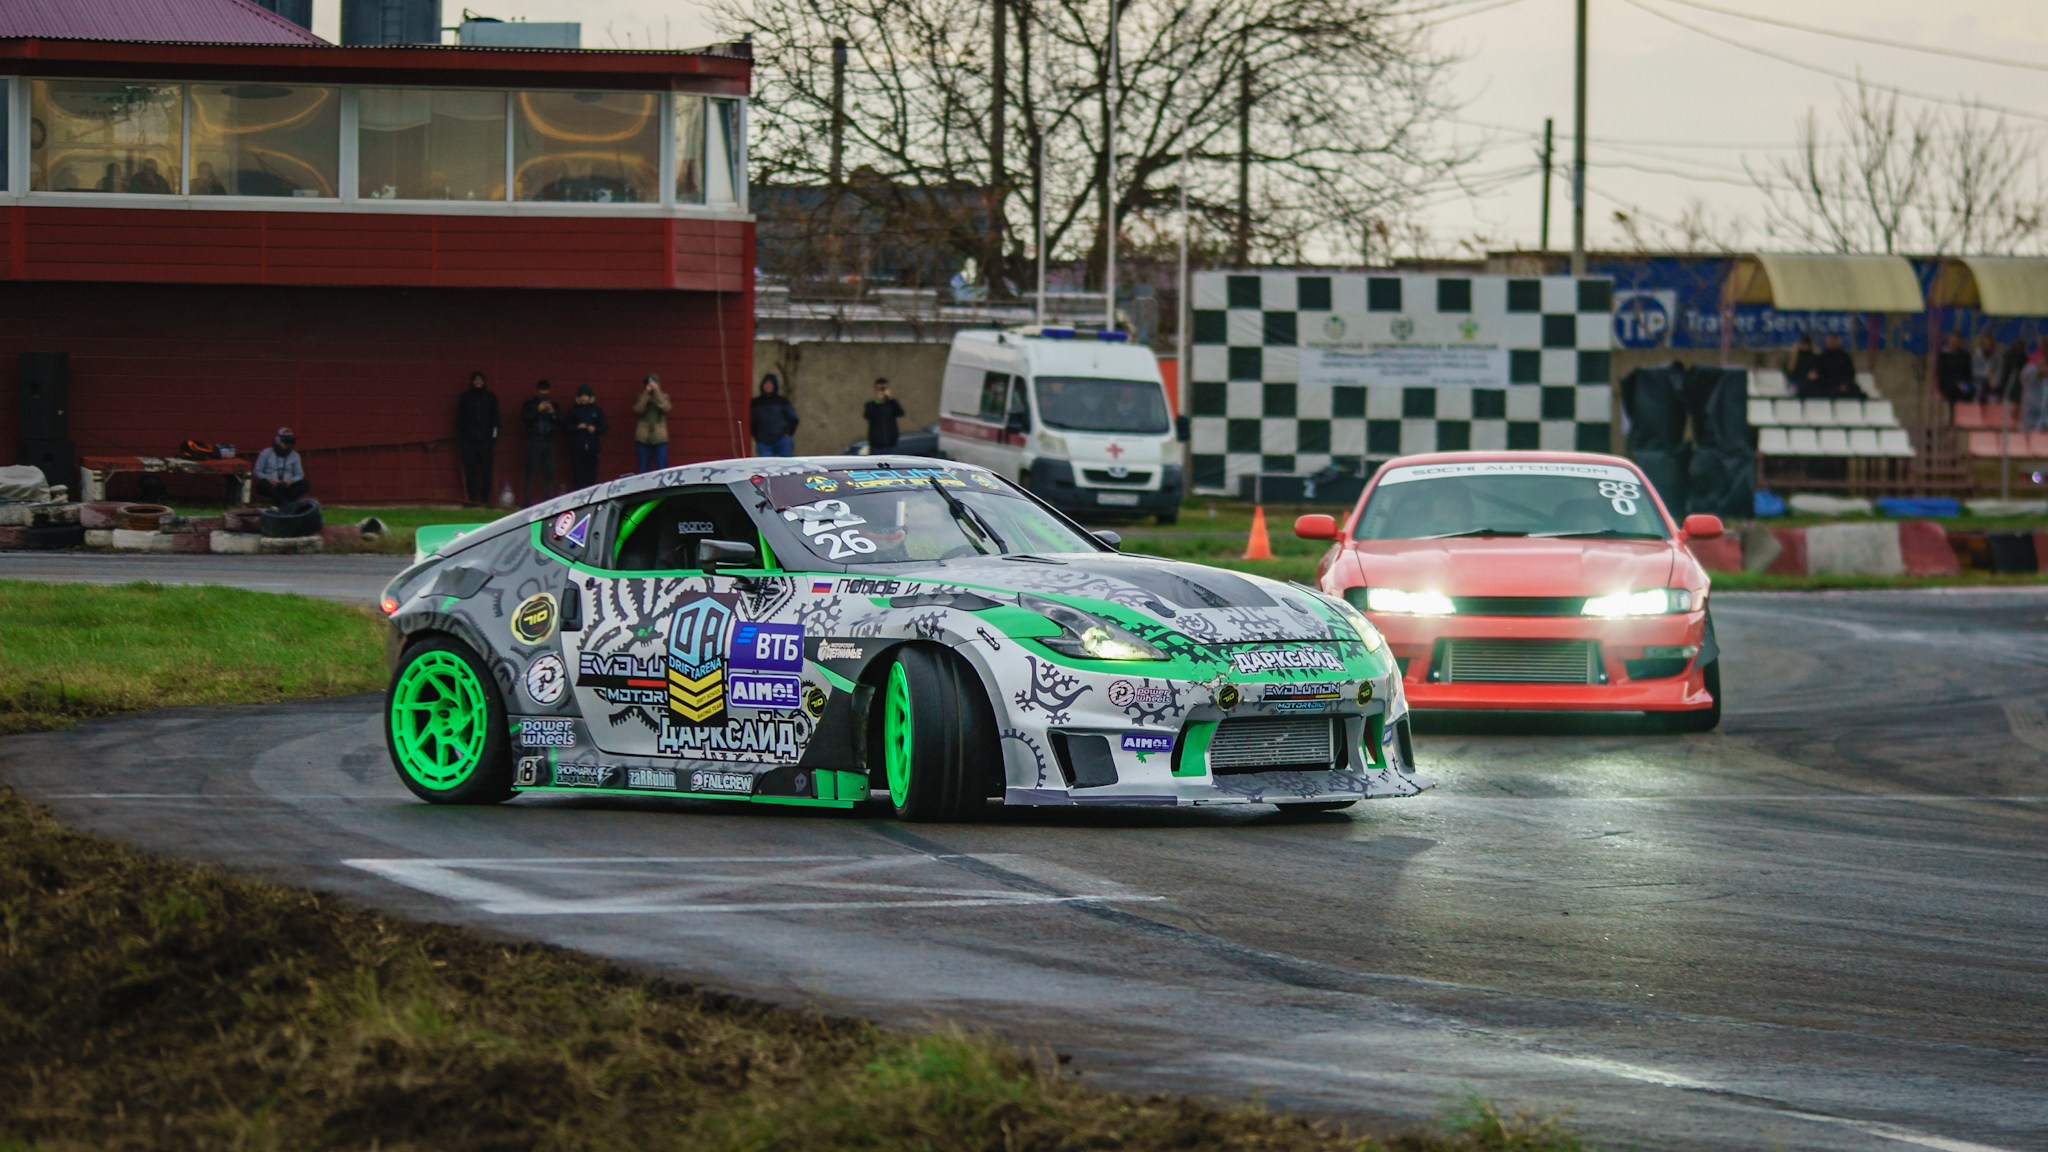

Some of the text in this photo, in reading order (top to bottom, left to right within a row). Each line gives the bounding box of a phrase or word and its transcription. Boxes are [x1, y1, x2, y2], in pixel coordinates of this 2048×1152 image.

[1622, 311, 1668, 340] TIP
[1761, 309, 1850, 333] Services
[1412, 465, 1608, 476] SOCHI AUTODROM
[1598, 481, 1641, 499] 88
[814, 529, 877, 560] 26
[755, 633, 800, 662] ВТБ
[1233, 646, 1345, 674] ДАРКСАЙД
[732, 681, 799, 703] AIMOL
[1136, 694, 1172, 703] wheels
[1137, 688, 1171, 697] power
[1264, 684, 1340, 696] EVOLUTION
[522, 720, 572, 733] power
[659, 712, 798, 757] ДАРКСАЙД
[522, 732, 575, 745] wheels
[1123, 737, 1170, 749] AIMOL
